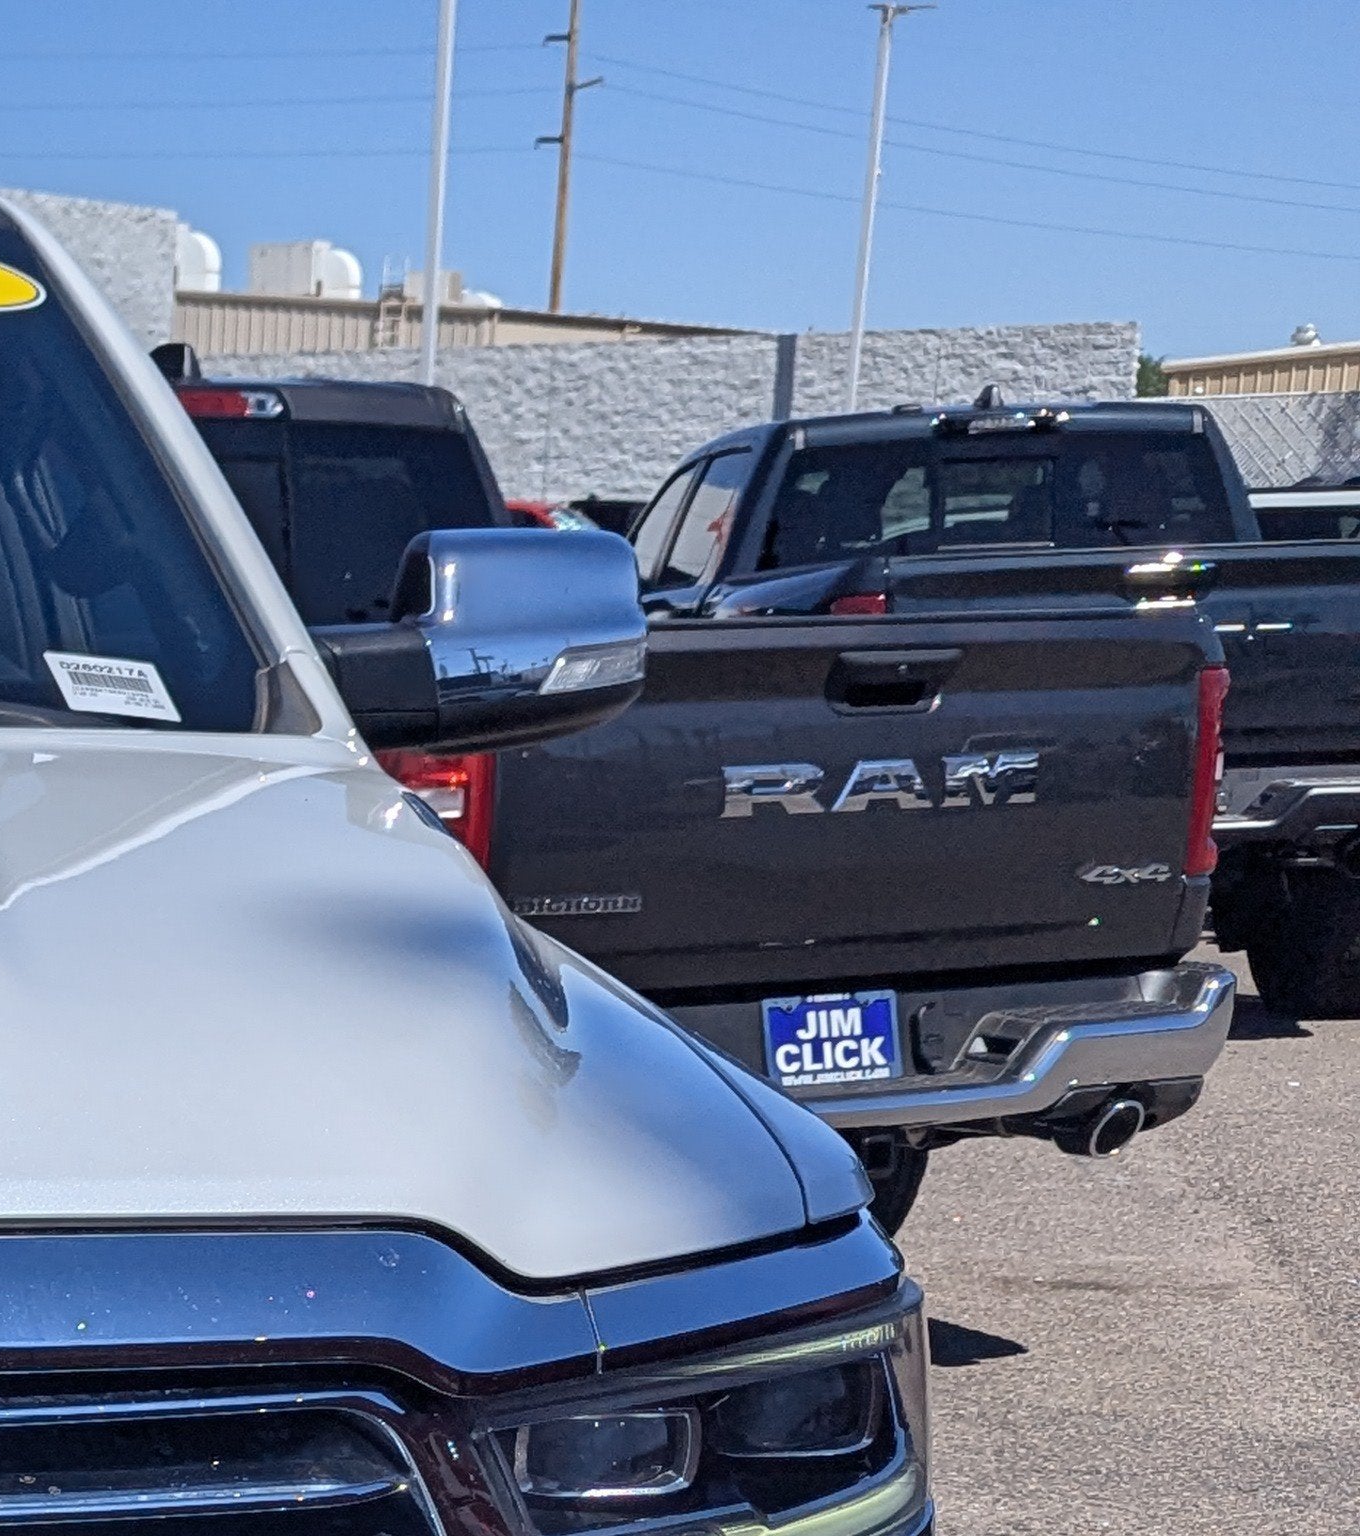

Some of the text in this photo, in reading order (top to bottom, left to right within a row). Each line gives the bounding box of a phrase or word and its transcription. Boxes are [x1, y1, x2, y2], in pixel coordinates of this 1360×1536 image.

[720, 752, 1040, 819] RAM
[795, 1006, 862, 1040] JIM
[775, 1035, 888, 1074] CLICK
